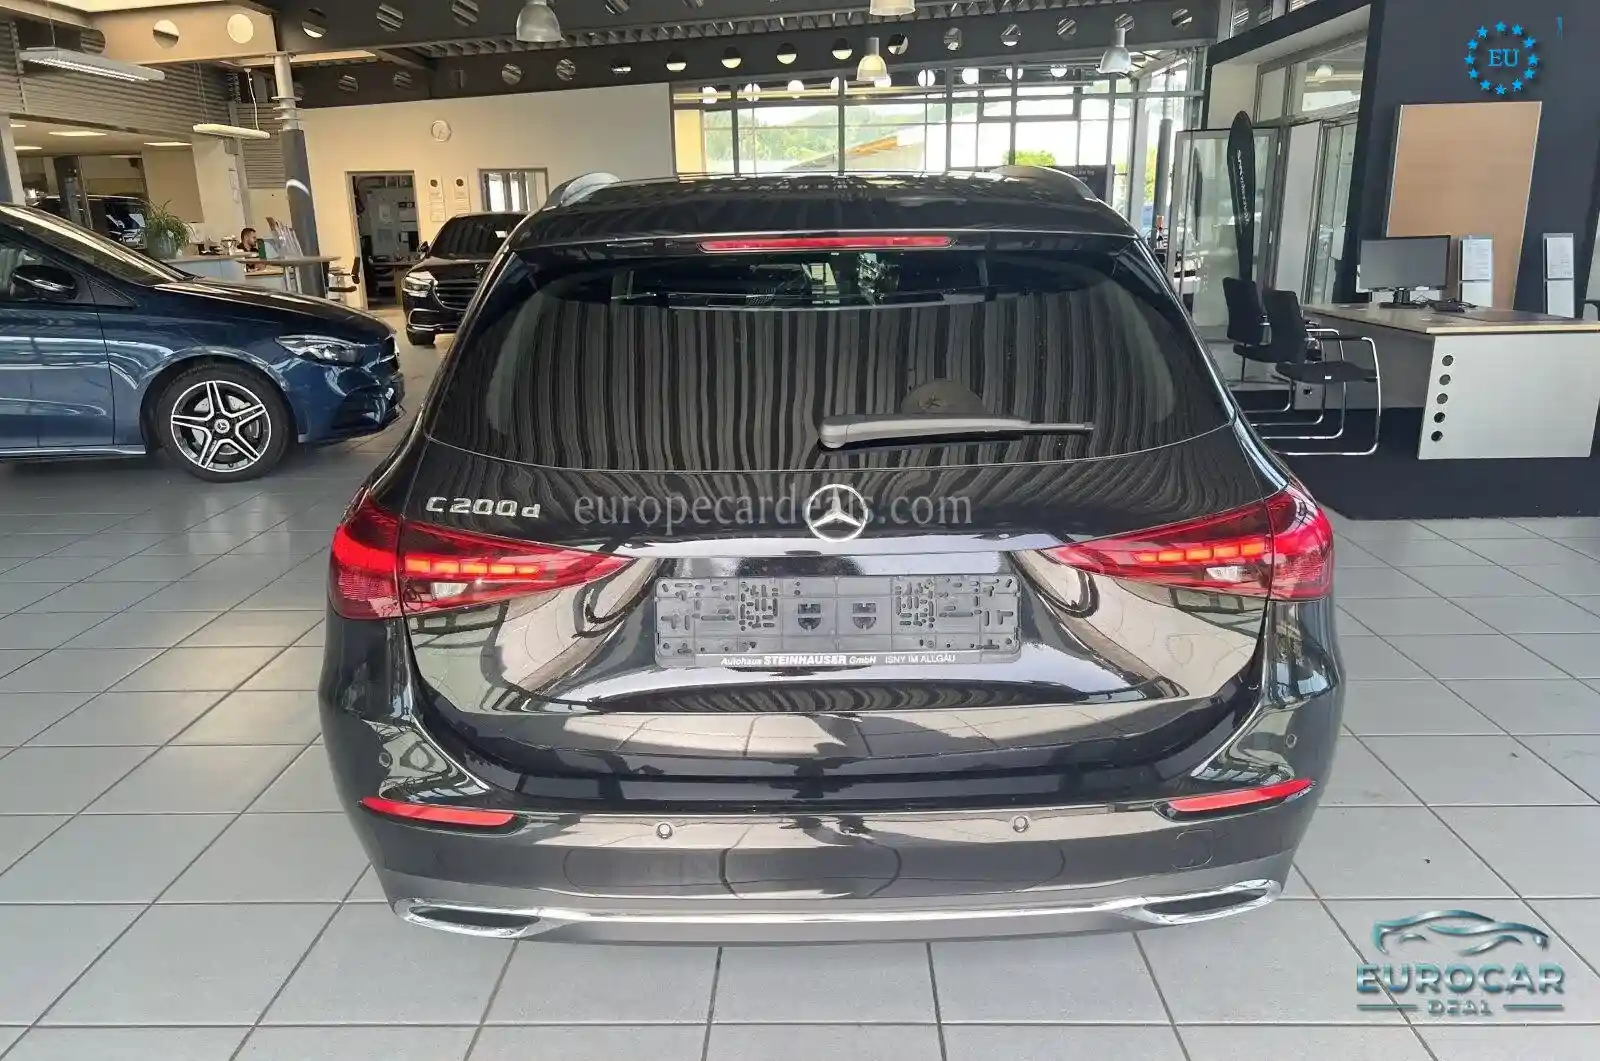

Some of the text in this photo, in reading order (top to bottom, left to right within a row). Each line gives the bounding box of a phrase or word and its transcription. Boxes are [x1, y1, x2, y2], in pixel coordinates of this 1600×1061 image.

[425, 496, 541, 519] C 200 d
[721, 657, 762, 666] Autohaus
[763, 655, 847, 665] STEINHAUSER
[849, 656, 877, 664] GmbH
[885, 655, 906, 664] ISNY
[908, 655, 919, 664] IM
